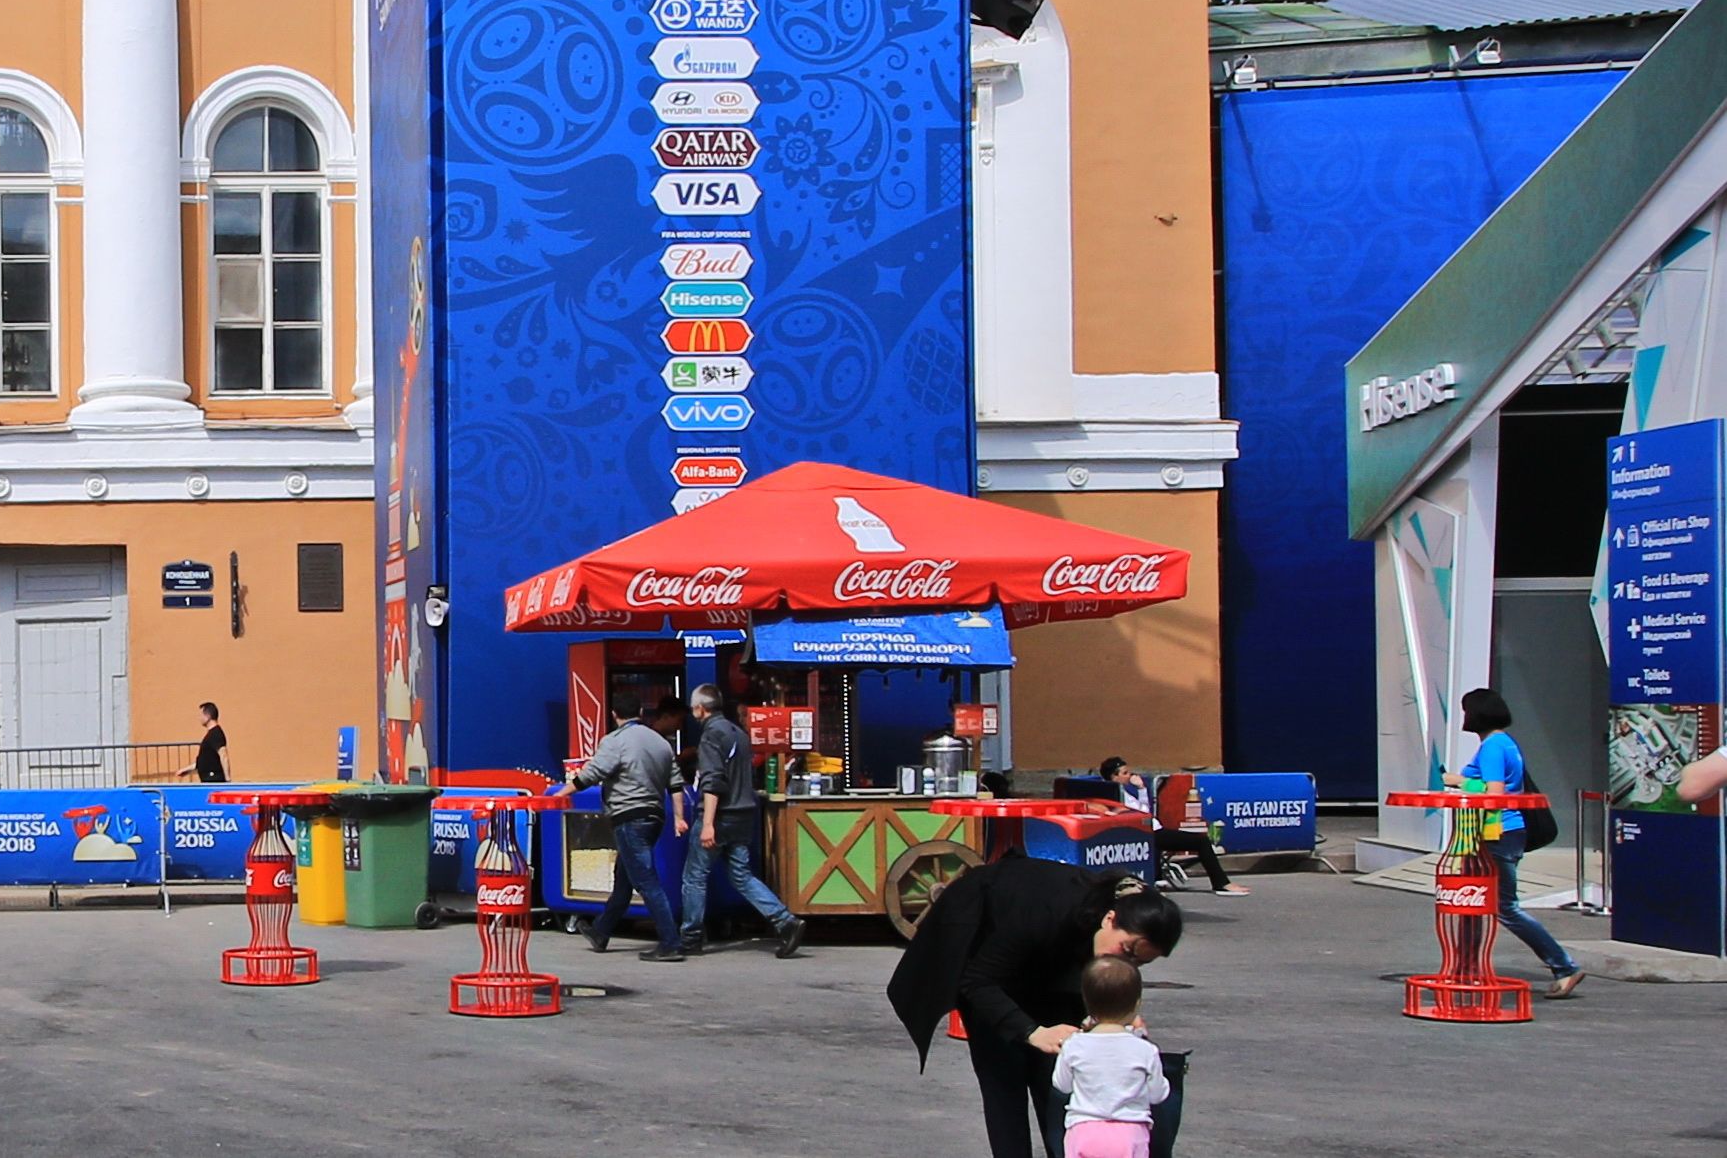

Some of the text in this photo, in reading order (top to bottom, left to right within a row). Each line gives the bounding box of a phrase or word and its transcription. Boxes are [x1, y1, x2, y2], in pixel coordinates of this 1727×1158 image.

[695, 17, 745, 29] WANDA
[692, 62, 737, 74] GAZPROM
[718, 95, 738, 103] KIA
[662, 107, 702, 115] HYUNDAI
[661, 131, 748, 157] QATAR
[682, 152, 749, 166] AIRWAYS
[669, 182, 740, 205] VISA
[677, 231, 701, 239] WORLD
[701, 231, 715, 239] CUP
[669, 248, 742, 275] Bud
[670, 292, 744, 306] Hisense
[1359, 363, 1455, 432] Hisense
[673, 400, 744, 422] vivo
[1612, 463, 1670, 485] Information
[1642, 516, 1710, 533] Official Fan Shop
[834, 559, 959, 601] Coca-Cola
[1042, 554, 1167, 595] Coca-Cola
[1642, 572, 1709, 587] Food & Beverage
[626, 566, 749, 606] Coca-Cola
[184, 596, 190, 606] 1
[1642, 612, 1706, 627] Medical Service
[842, 632, 916, 643] ГОРЯЧАЯ
[793, 642, 877, 652] КУКУРУЗА
[894, 643, 972, 654] ПОПКОРН
[818, 654, 841, 662] HOT
[843, 653, 877, 662] CORN
[878, 654, 889, 662] &
[889, 654, 915, 662] POP
[1643, 668, 1670, 681] Toilets
[1226, 800, 1308, 817] FIFA FAN FEST
[174, 818, 238, 832] RUSSIA
[1234, 816, 1301, 829] SAINT PETERSBURG
[433, 822, 470, 839] RUSSIA
[175, 833, 215, 848] 2018
[433, 839, 456, 855] 2018
[477, 884, 526, 905] Coca-Cola
